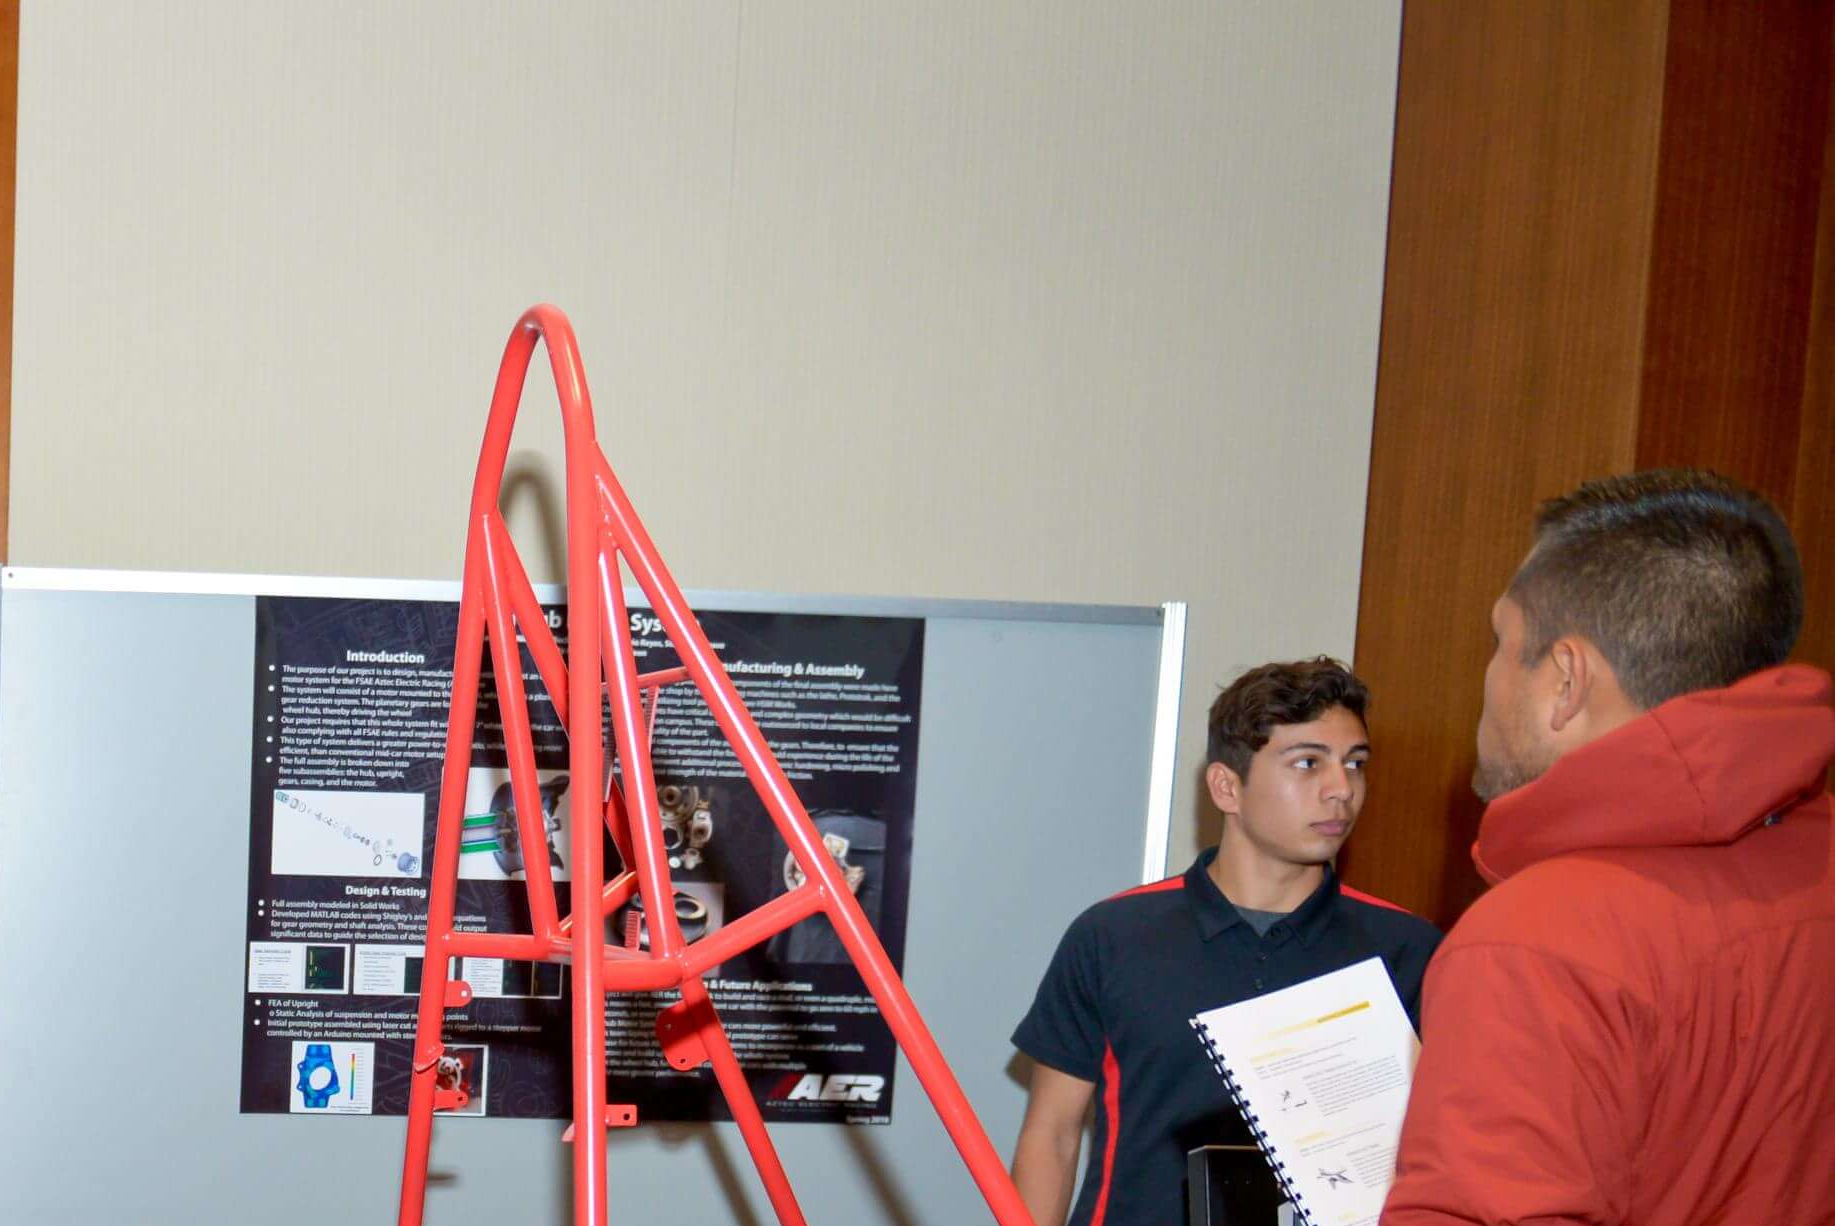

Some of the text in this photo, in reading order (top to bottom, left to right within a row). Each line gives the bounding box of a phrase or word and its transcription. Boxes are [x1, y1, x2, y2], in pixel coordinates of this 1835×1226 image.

[347, 650, 424, 664] Introduction
[722, 661, 865, 680] nufacturing & Assembly
[345, 885, 427, 899] Design & Testing
[271, 899, 285, 907] Full
[285, 900, 318, 910] assembly
[319, 900, 351, 909] modeled
[360, 902, 378, 910] Solid
[378, 902, 400, 910] Works
[271, 909, 310, 920] Developed
[310, 910, 340, 918] MATLAB
[340, 911, 361, 919] codes
[362, 911, 381, 921] using
[414, 912, 428, 920] and
[270, 929, 306, 939] significant
[307, 930, 323, 938] data
[332, 930, 353, 941] guide
[354, 931, 366, 939] the
[368, 931, 399, 940] selection
[719, 980, 752, 990] Future
[268, 999, 282, 1007] FEA
[291, 999, 319, 1010] Upright
[275, 1009, 294, 1017] Static
[296, 1009, 324, 1019] Analysis
[334, 1010, 372, 1020] suspension
[374, 1011, 388, 1019] and
[388, 1011, 409, 1019] motor
[446, 1013, 468, 1023] points
[266, 1028, 302, 1037] controlled
[324, 1030, 352, 1038] Arduino
[352, 1030, 385, 1038] mounted
[386, 1031, 402, 1039] with
[787, 1074, 884, 1102] AER
